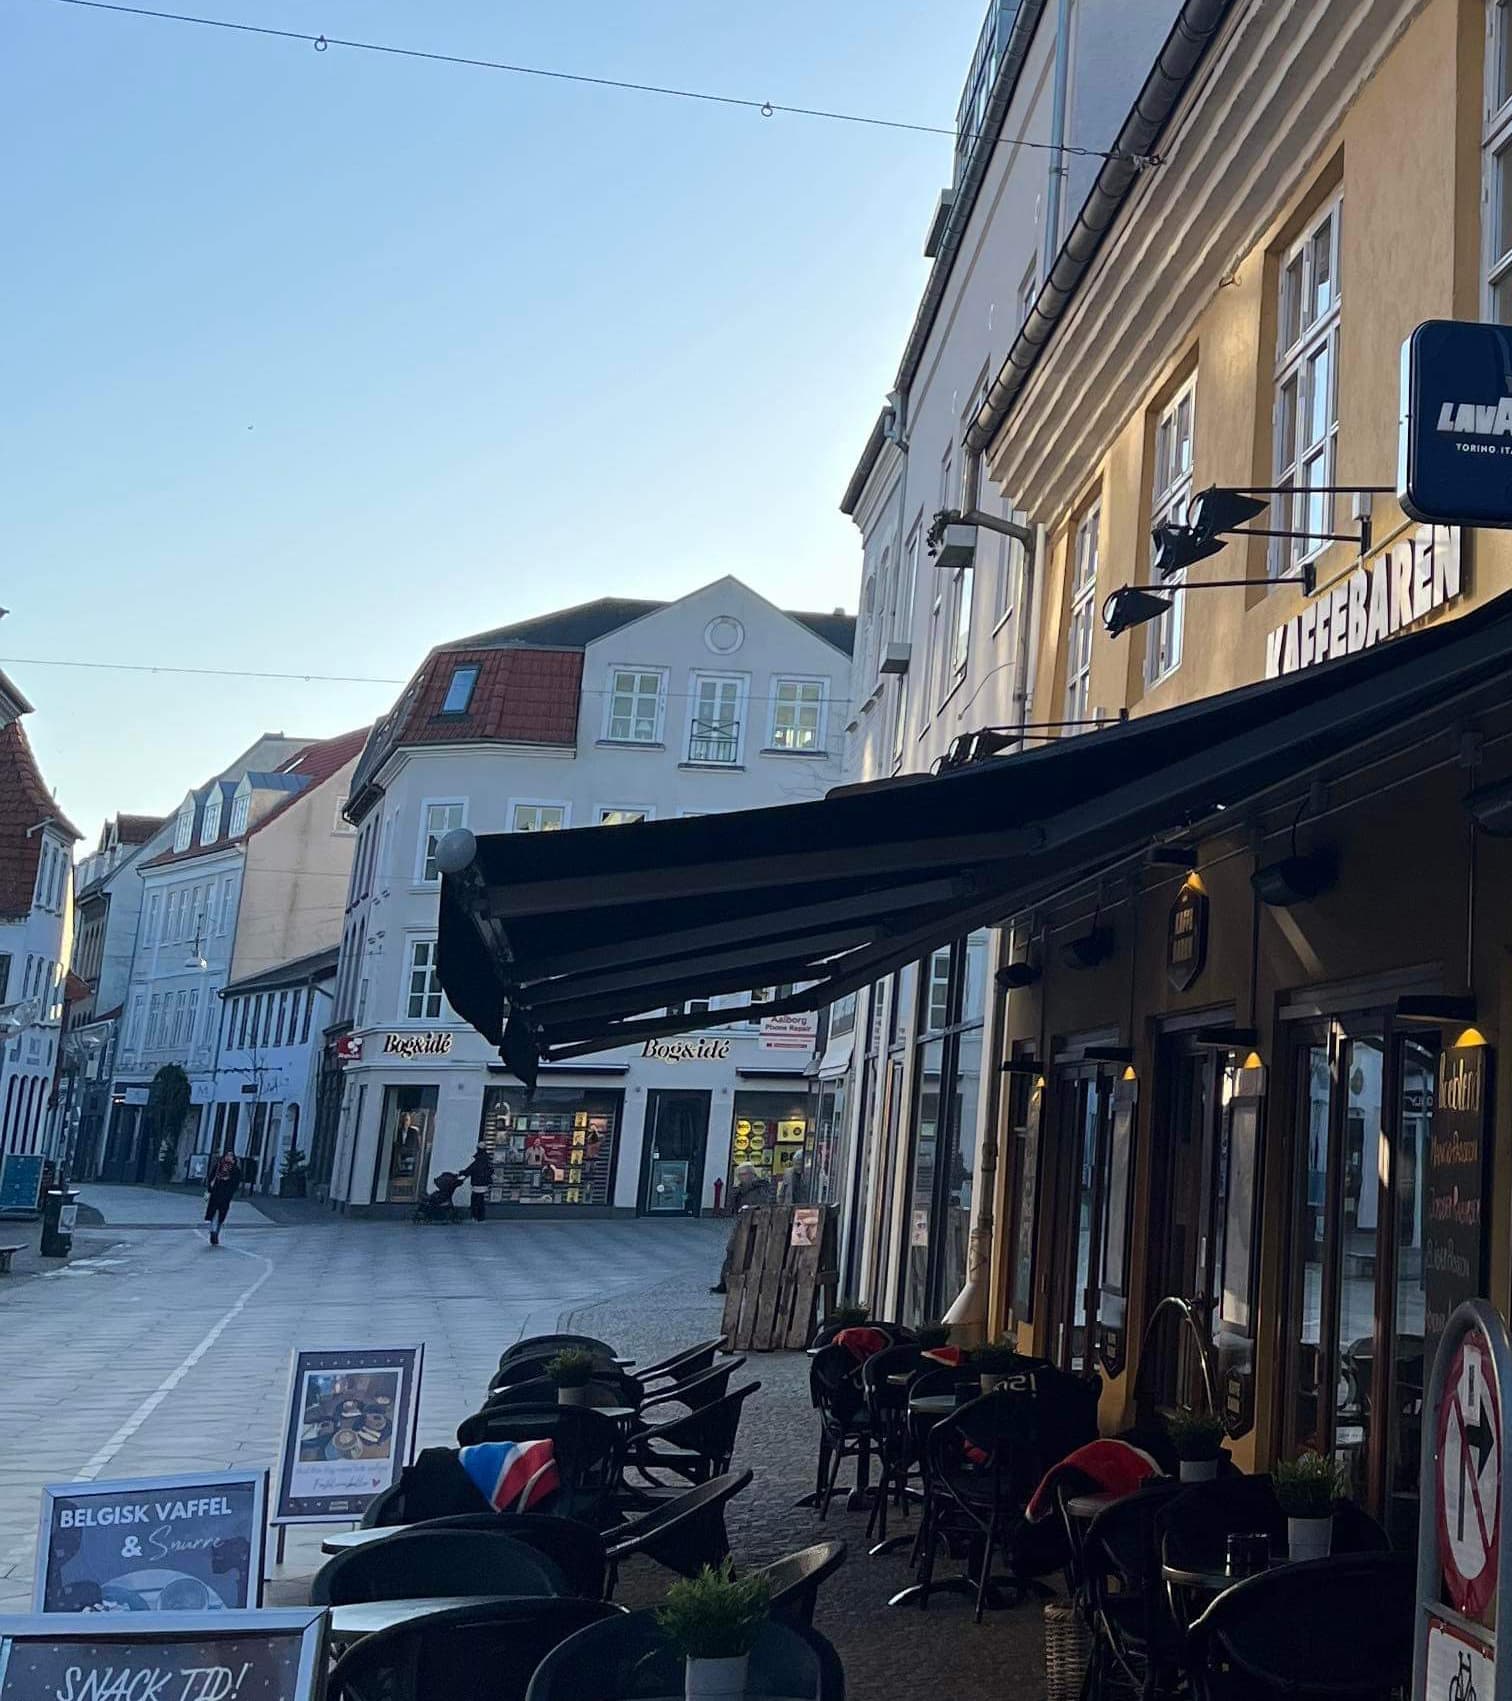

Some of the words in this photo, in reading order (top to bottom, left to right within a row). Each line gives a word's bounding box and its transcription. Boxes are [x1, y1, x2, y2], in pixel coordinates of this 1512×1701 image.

[1265, 524, 1461, 680] KAFFEBAREN
[765, 1024, 788, 1032] Phone
[789, 1025, 812, 1034] Repair
[770, 1015, 807, 1026] Aalborg
[383, 1031, 452, 1059] Bog&idé
[640, 1039, 730, 1062] Bog&idé
[60, 1503, 150, 1528] BELGISK
[155, 1496, 233, 1521] VAFFEL
[121, 1535, 143, 1558] &
[57, 1666, 173, 1701] SNACK
[180, 1662, 250, 1701] TID!
